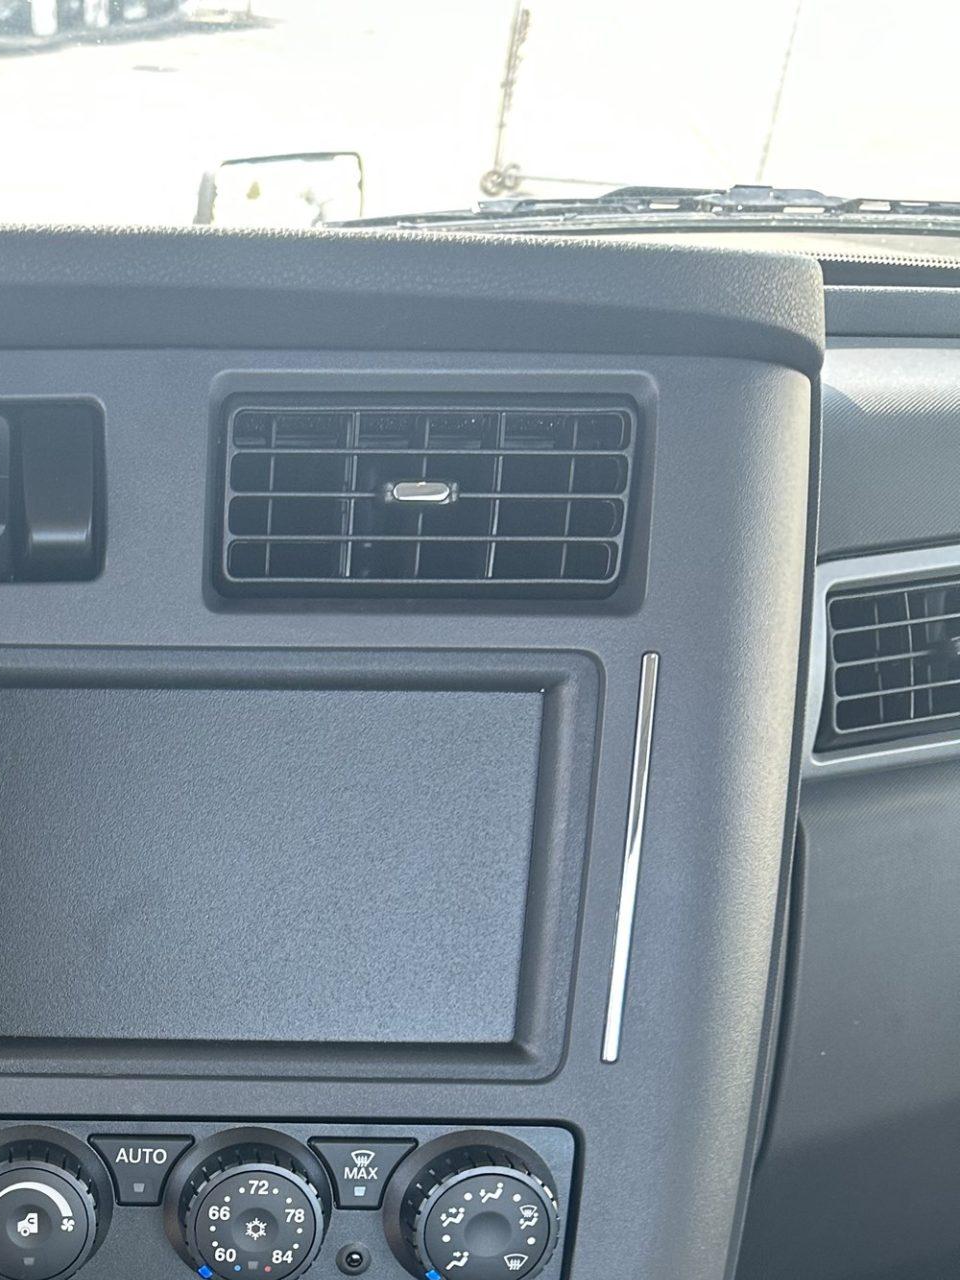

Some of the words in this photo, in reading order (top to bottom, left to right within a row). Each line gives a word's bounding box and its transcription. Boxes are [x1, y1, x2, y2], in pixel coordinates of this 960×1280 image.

[116, 1148, 168, 1164] AUTO
[344, 1166, 378, 1180] MAX
[248, 1181, 269, 1195] 72
[208, 1206, 230, 1220] 66
[284, 1209, 305, 1223] 78
[214, 1248, 236, 1262] 60
[272, 1250, 293, 1264] 84
